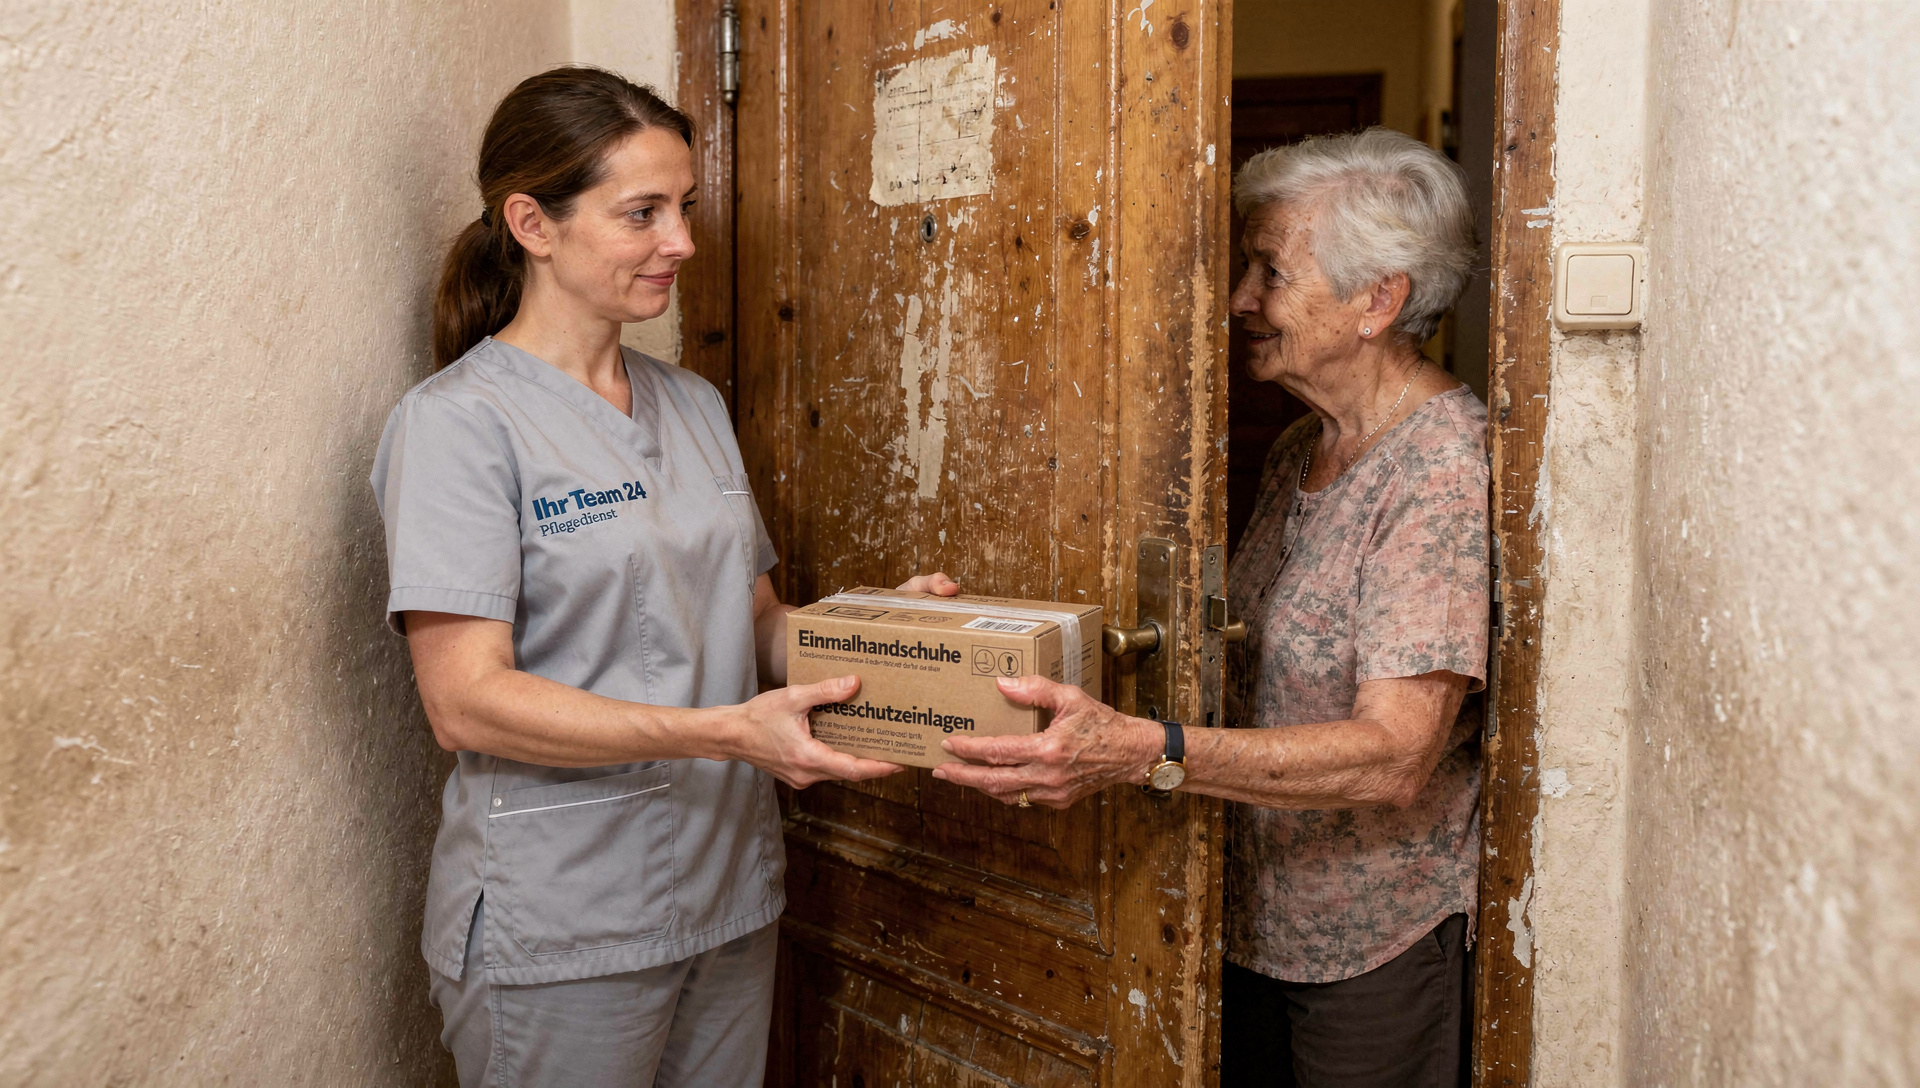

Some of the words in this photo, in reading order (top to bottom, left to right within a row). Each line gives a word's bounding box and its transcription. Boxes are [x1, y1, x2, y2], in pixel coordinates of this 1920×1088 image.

[532, 497, 569, 521] Ihr
[568, 488, 625, 510] Team
[622, 480, 647, 501] 24
[539, 508, 618, 537] Pflegedienst
[798, 629, 962, 664] Einmalhandschuhe
